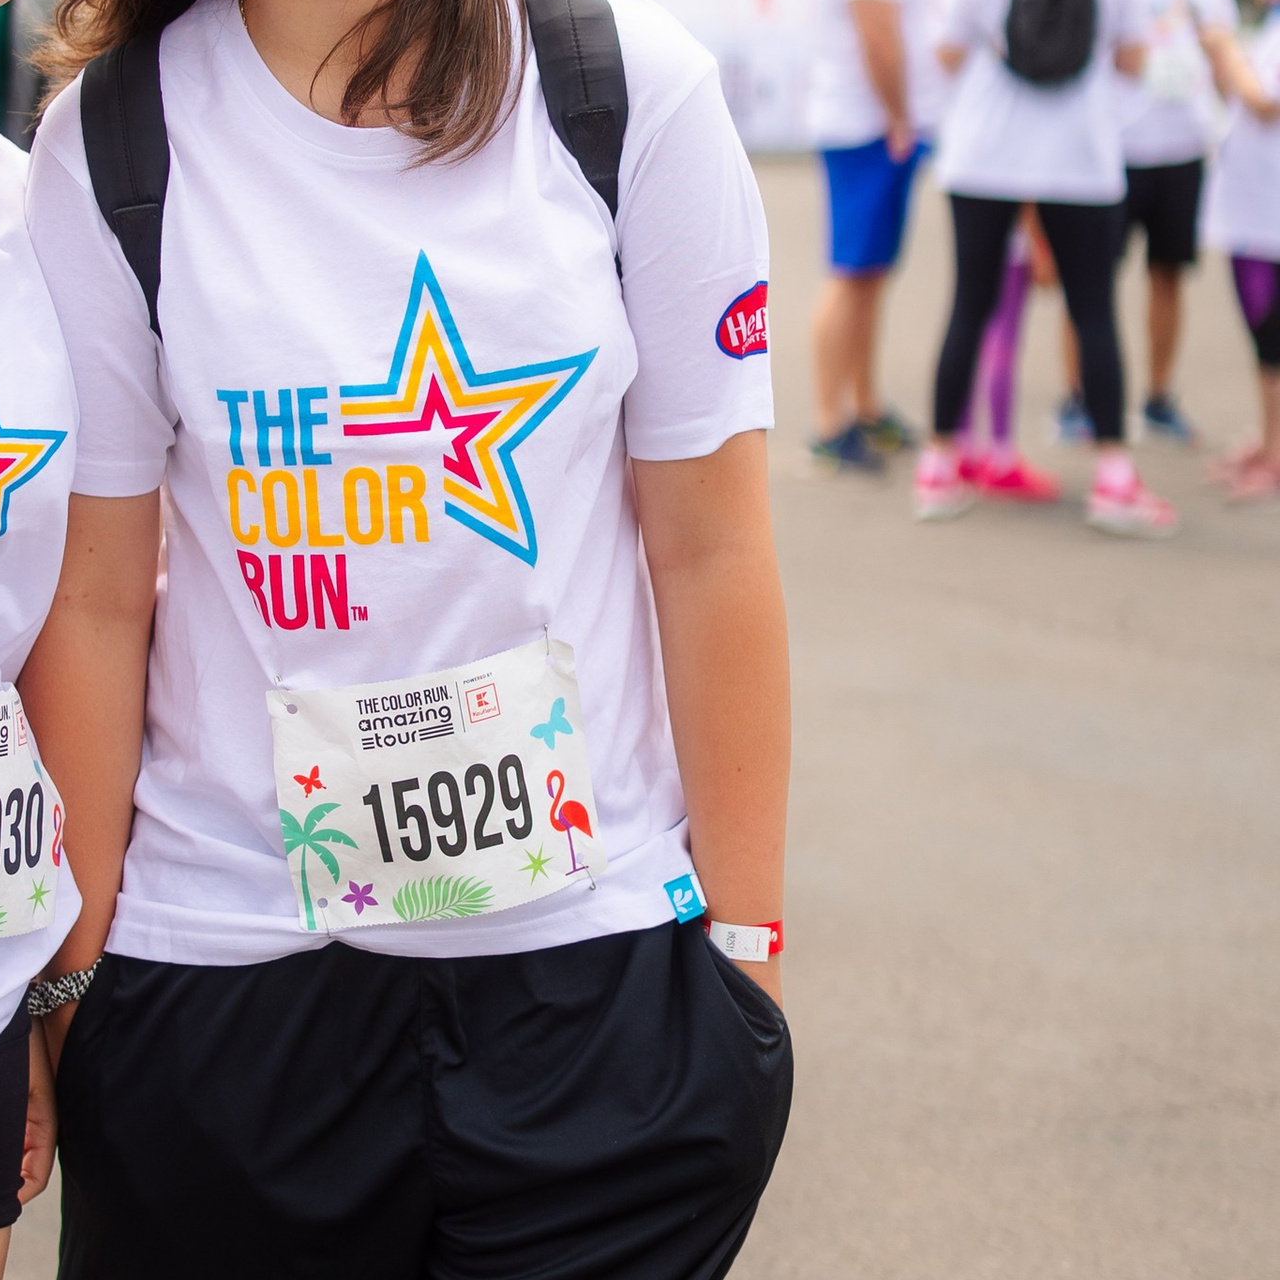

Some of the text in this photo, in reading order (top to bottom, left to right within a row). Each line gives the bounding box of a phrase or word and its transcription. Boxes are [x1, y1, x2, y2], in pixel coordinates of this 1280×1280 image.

[216, 386, 332, 468] THE
[226, 464, 430, 548] COLOR
[356, 697, 381, 716] THE
[381, 691, 423, 712] COLOR
[358, 705, 452, 732] amazing
[374, 730, 417, 748] tour
[362, 753, 534, 863] 15929
